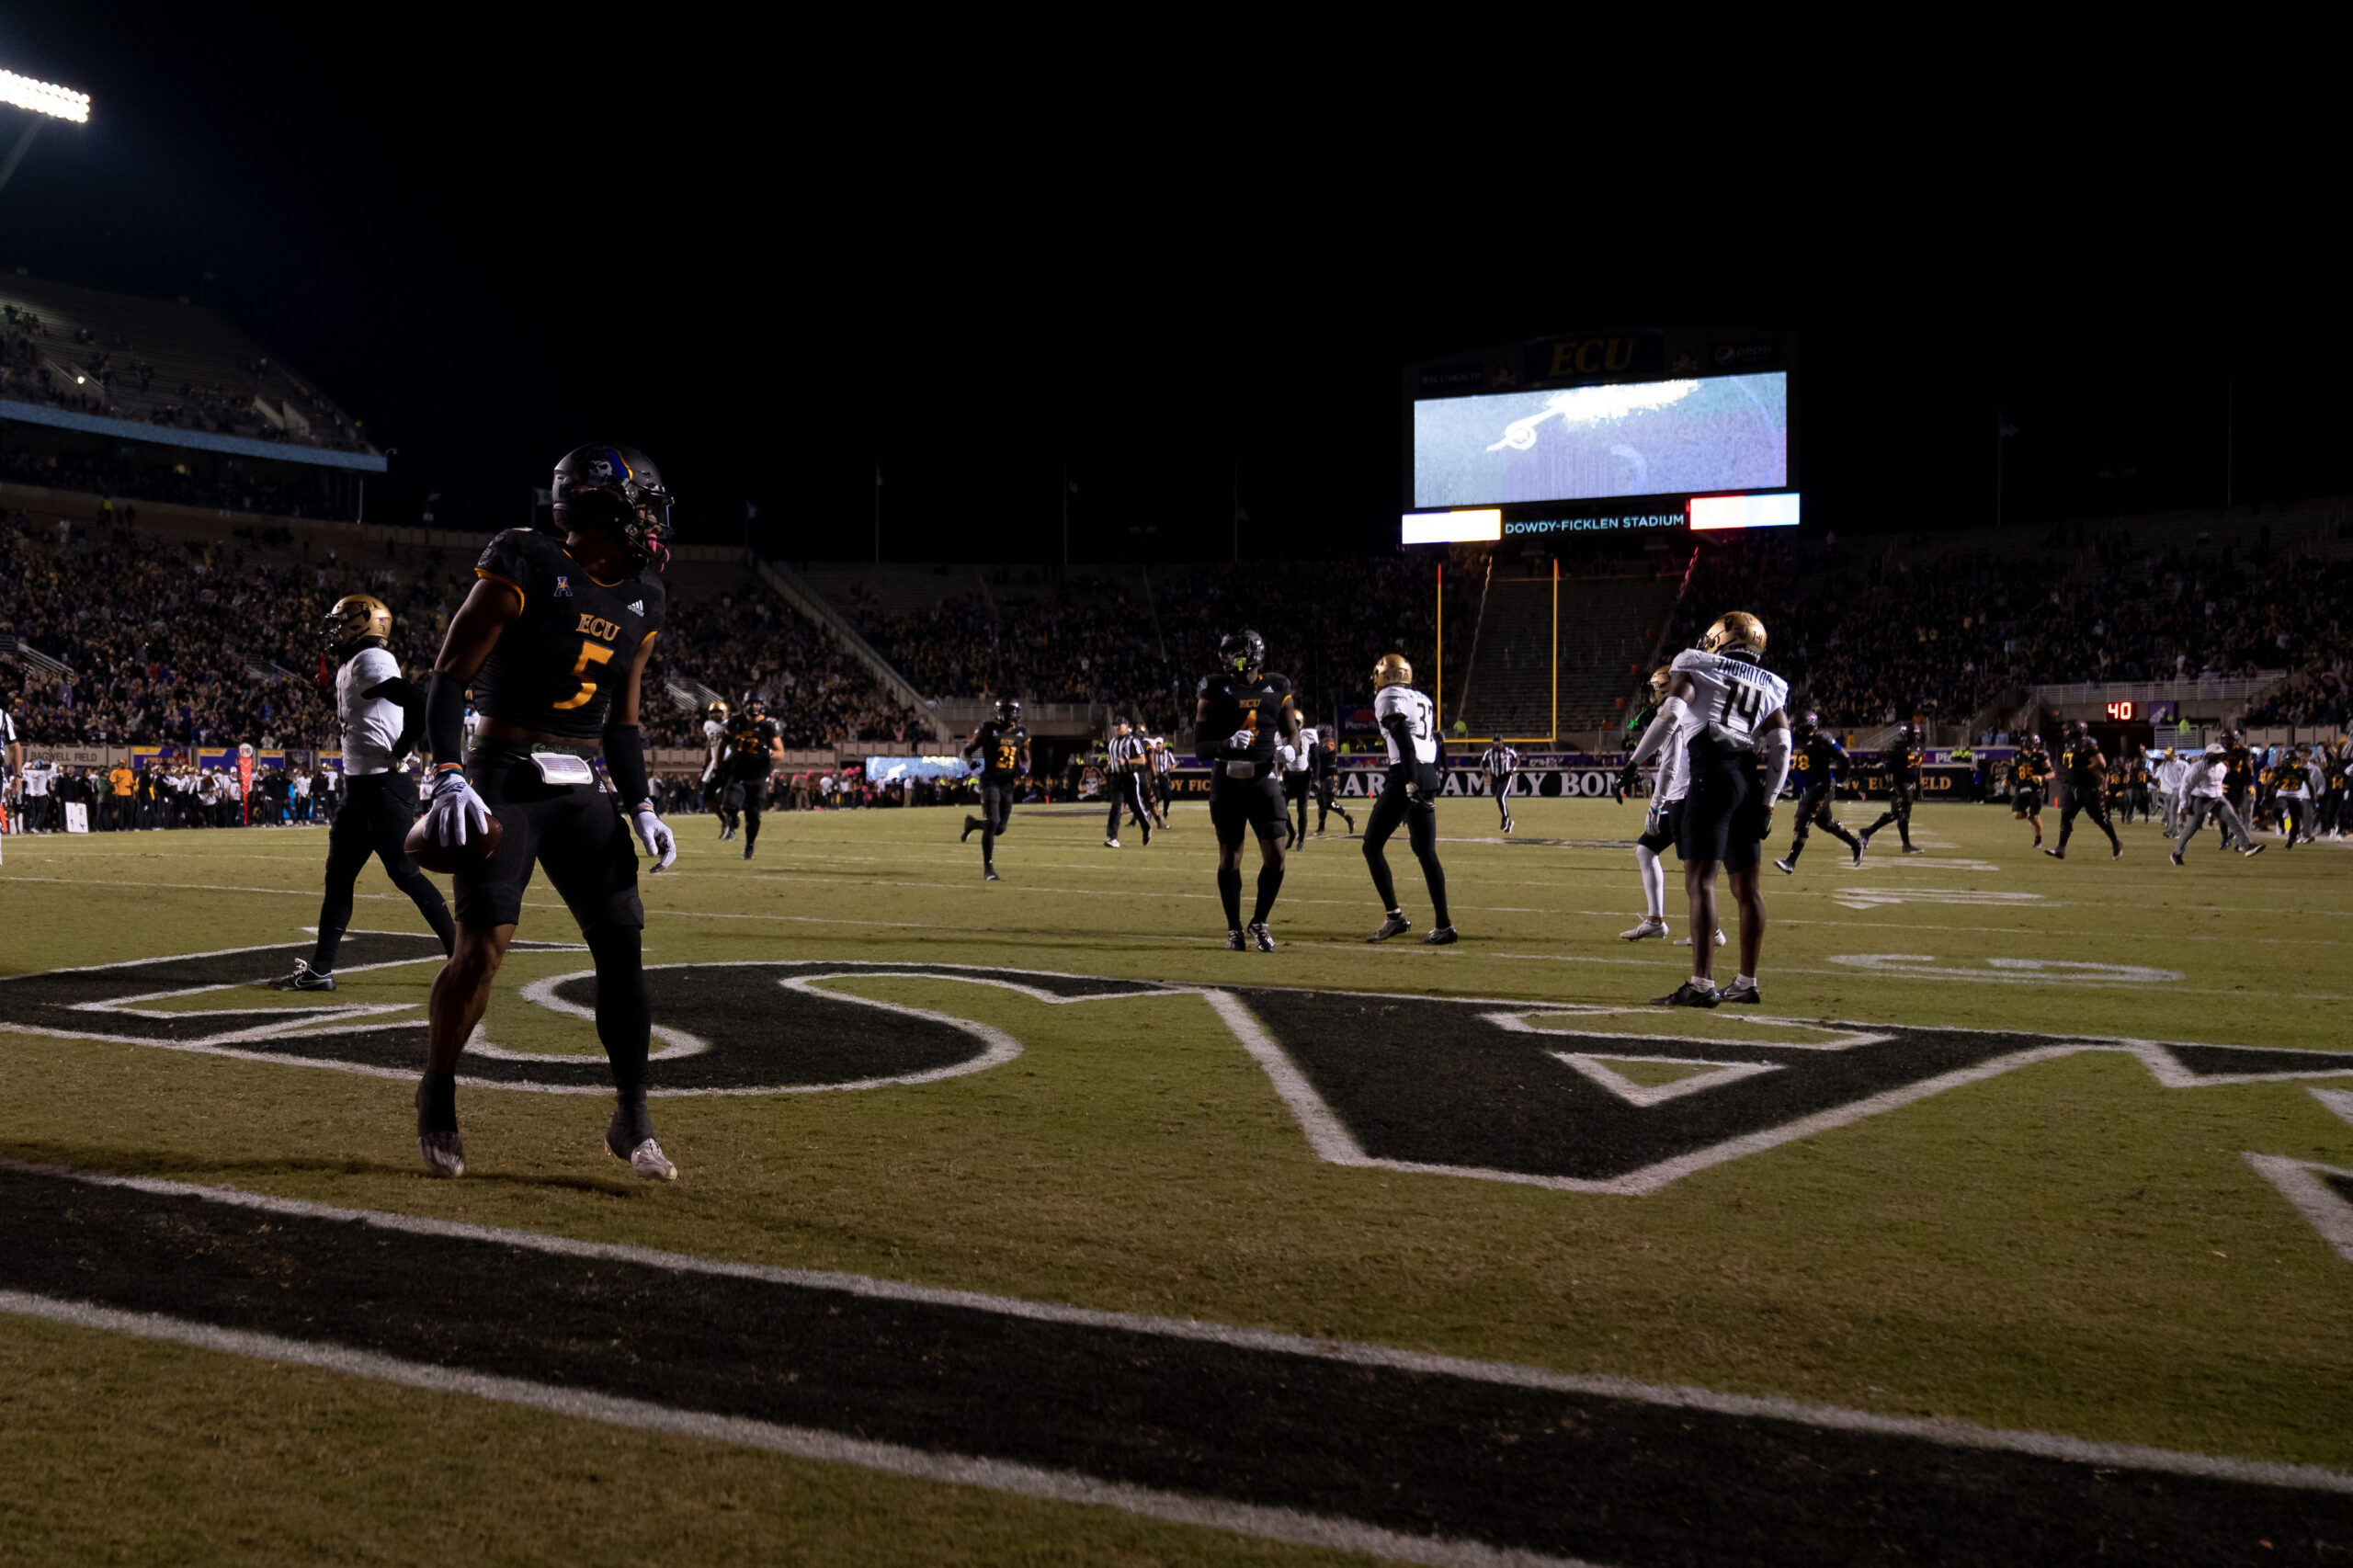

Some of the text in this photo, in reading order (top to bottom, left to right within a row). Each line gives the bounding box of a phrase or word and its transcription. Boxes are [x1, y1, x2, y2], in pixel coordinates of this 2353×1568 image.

[1550, 337, 1637, 377] ECU
[1505, 514, 1685, 534] DOWDY-FICKLEN STADIUM
[575, 612, 621, 642] ECU
[553, 639, 615, 710] 5
[1721, 679, 1762, 733] 14
[2107, 701, 2132, 721] 40
[30, 752, 97, 762] BAGWELL FIELD
[995, 746, 1017, 770] 21
